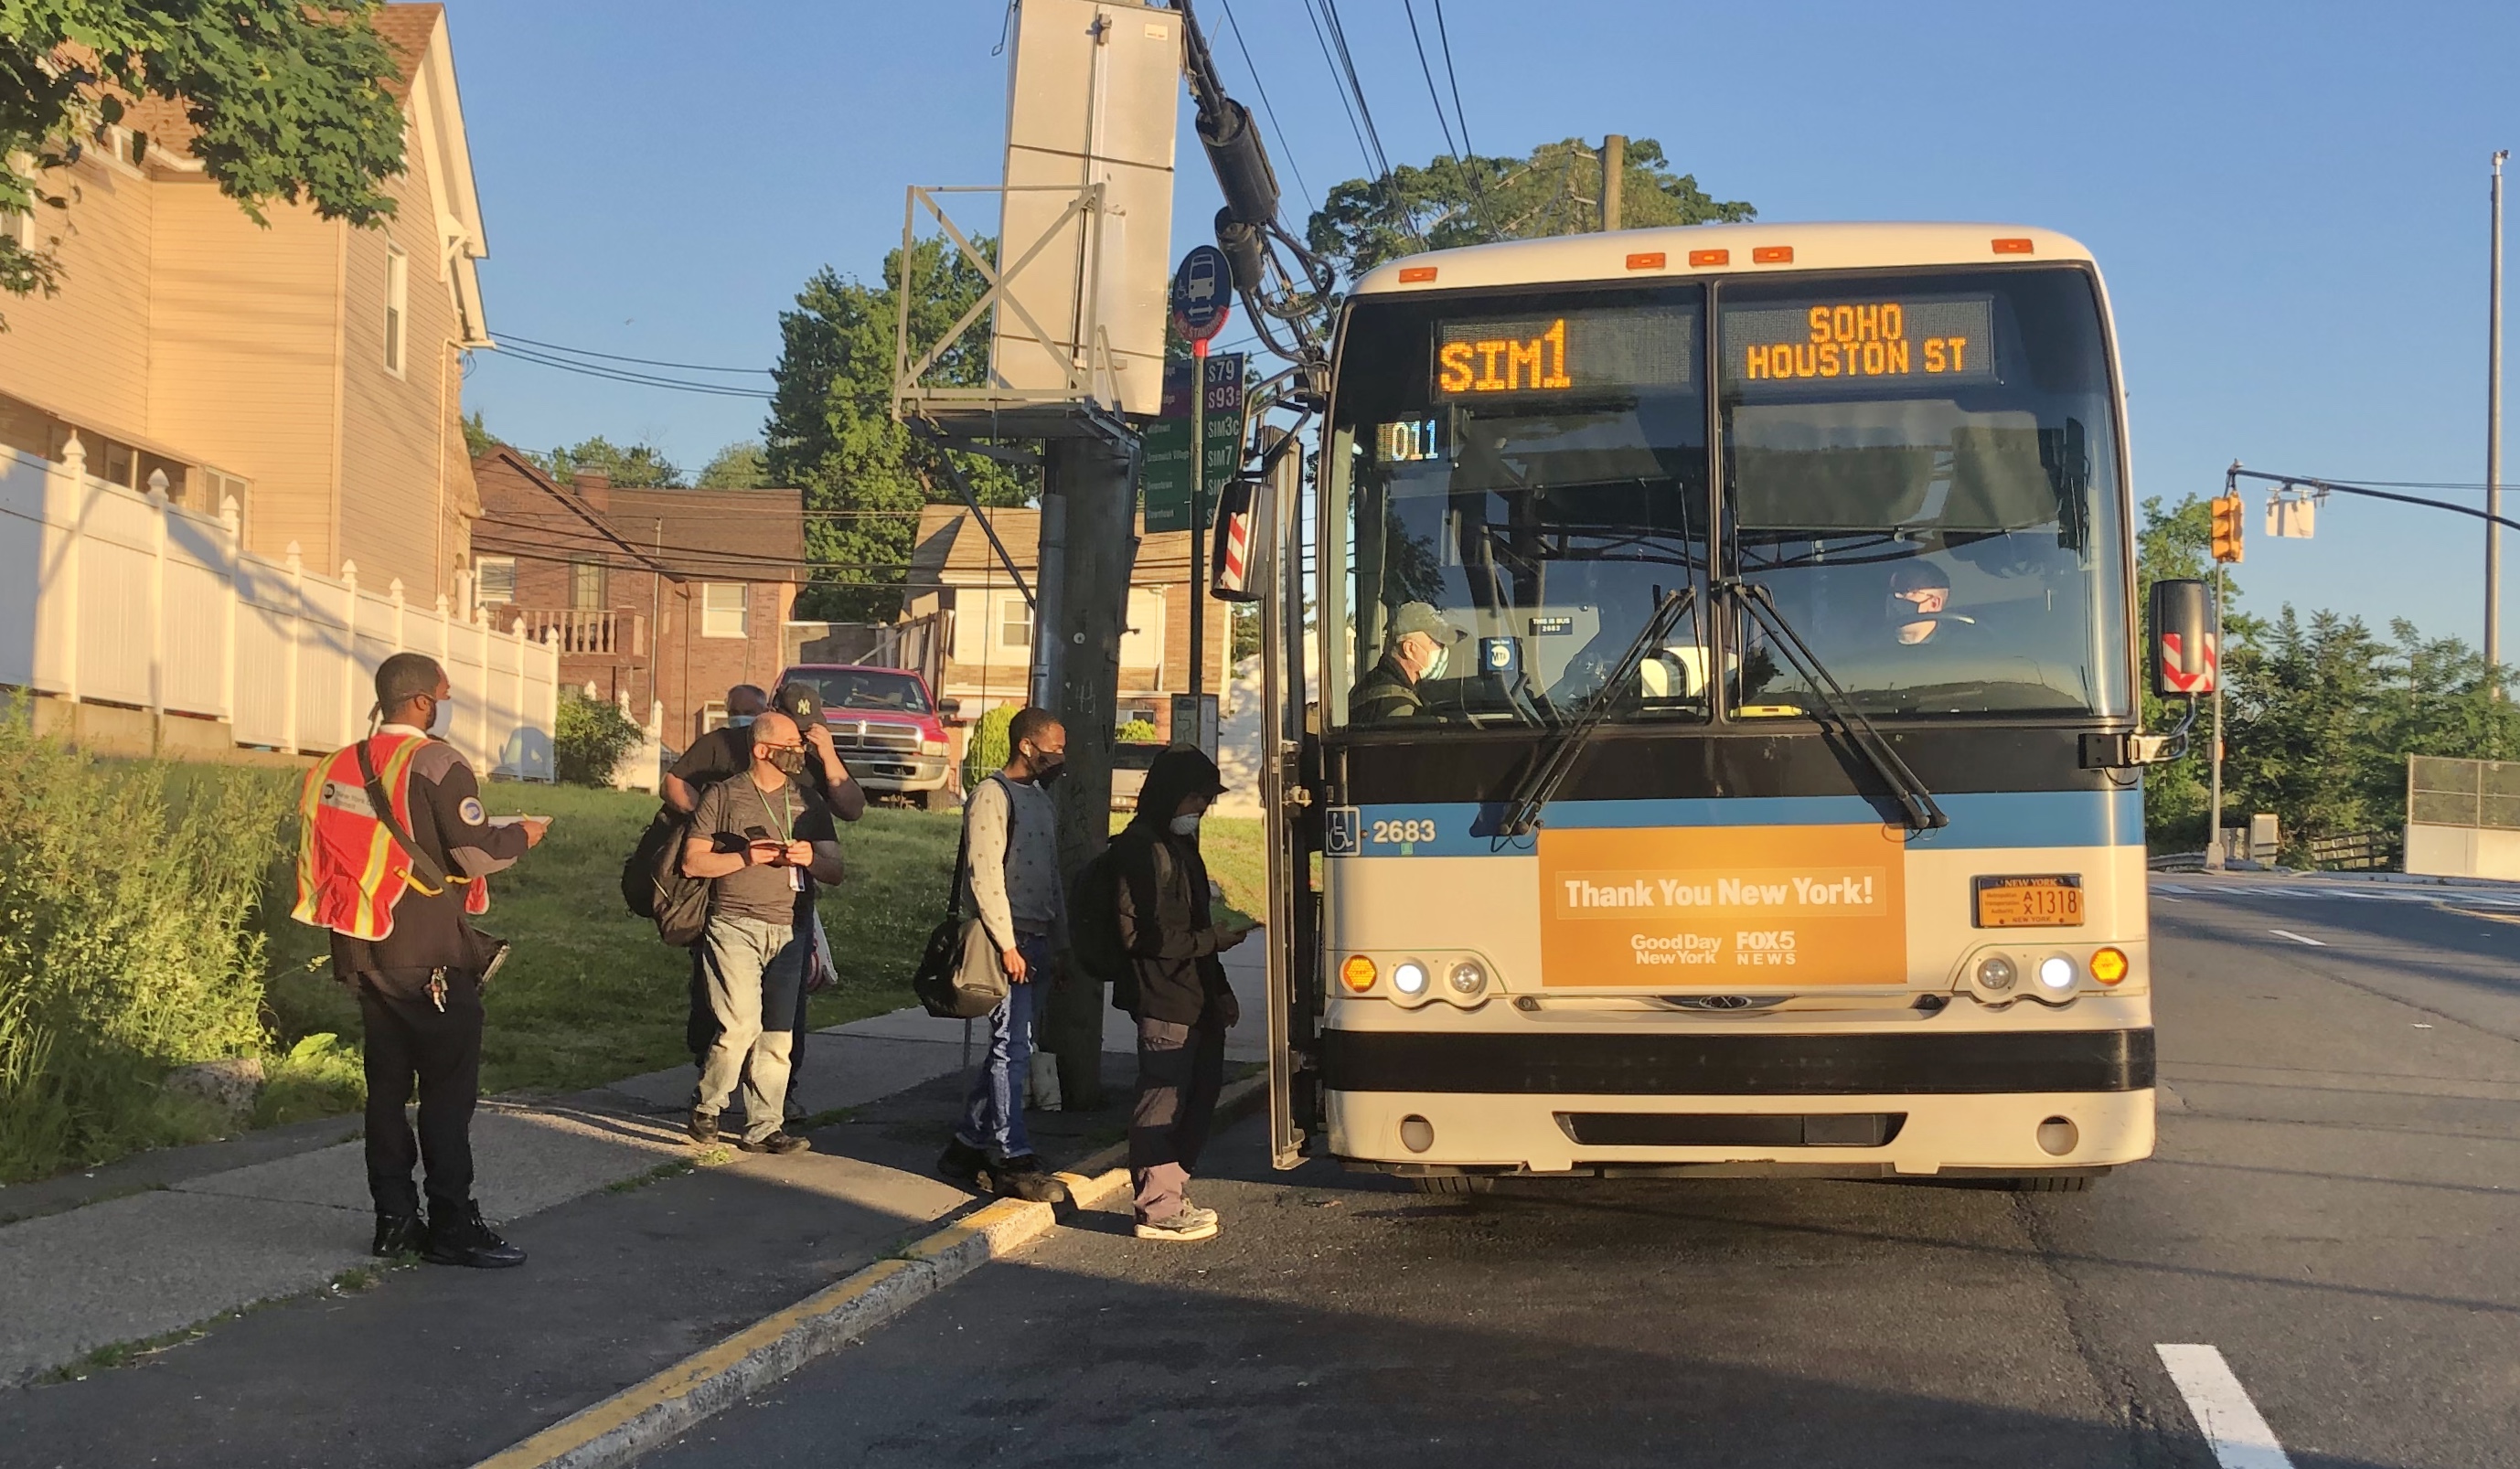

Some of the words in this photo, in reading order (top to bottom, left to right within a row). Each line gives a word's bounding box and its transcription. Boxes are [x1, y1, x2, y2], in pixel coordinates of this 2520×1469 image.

[1810, 303, 1903, 343] SOHO
[1439, 318, 1571, 391] SIM1
[1746, 337, 1908, 379] HOUSTON
[1924, 336, 1967, 373] ST
[1208, 359, 1234, 382] S79
[1208, 386, 1234, 409] S93
[1208, 416, 1240, 438] SIM3C
[1207, 445, 1233, 467] SIM7
[1372, 819, 1436, 844] 2683
[1564, 879, 1655, 908] Thank
[1658, 878, 1712, 907] You
[1717, 878, 1789, 906] New
[1792, 876, 1874, 905] York!
[2004, 879, 2029, 888] NEW
[2031, 878, 2057, 887] YORK
[1737, 953, 1796, 965] NEWS
